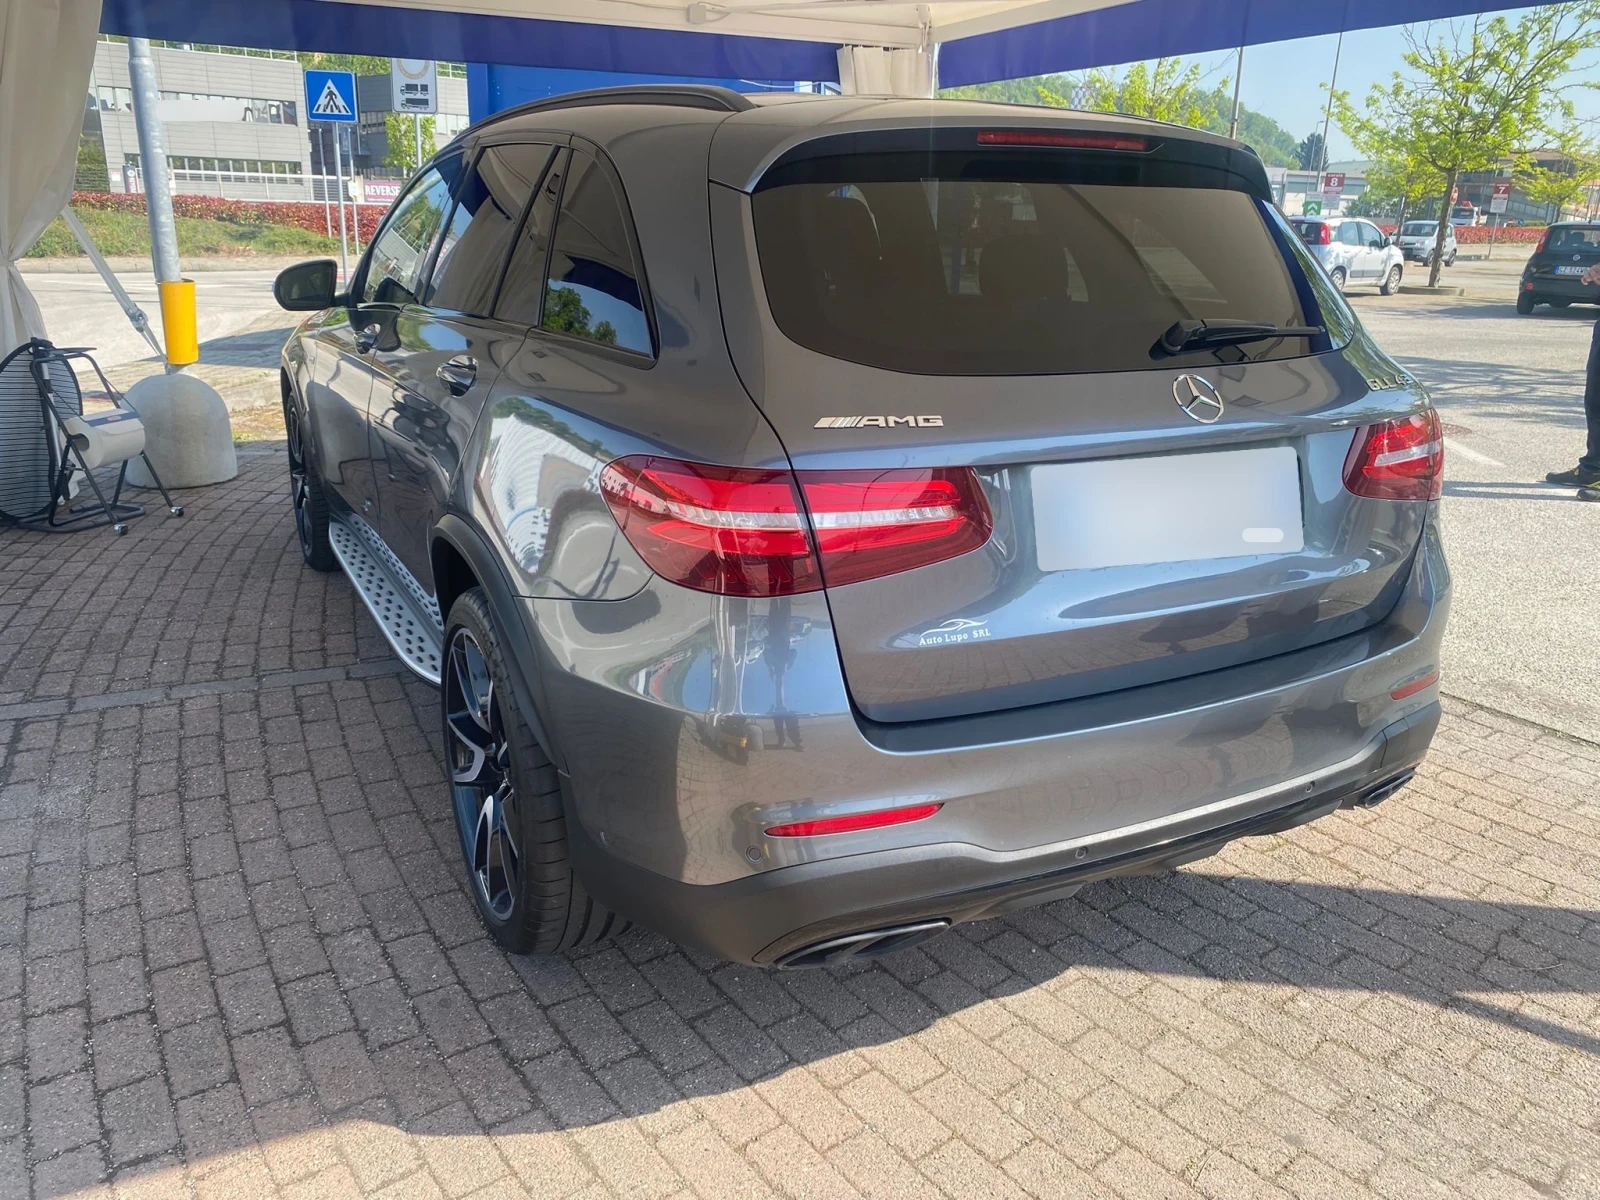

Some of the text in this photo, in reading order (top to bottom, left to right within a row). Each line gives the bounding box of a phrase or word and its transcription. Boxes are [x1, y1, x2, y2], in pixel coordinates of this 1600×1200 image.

[1330, 178, 1338, 187] 8
[856, 415, 944, 428] AMG
[919, 628, 991, 646] Auto Lupo SRL
